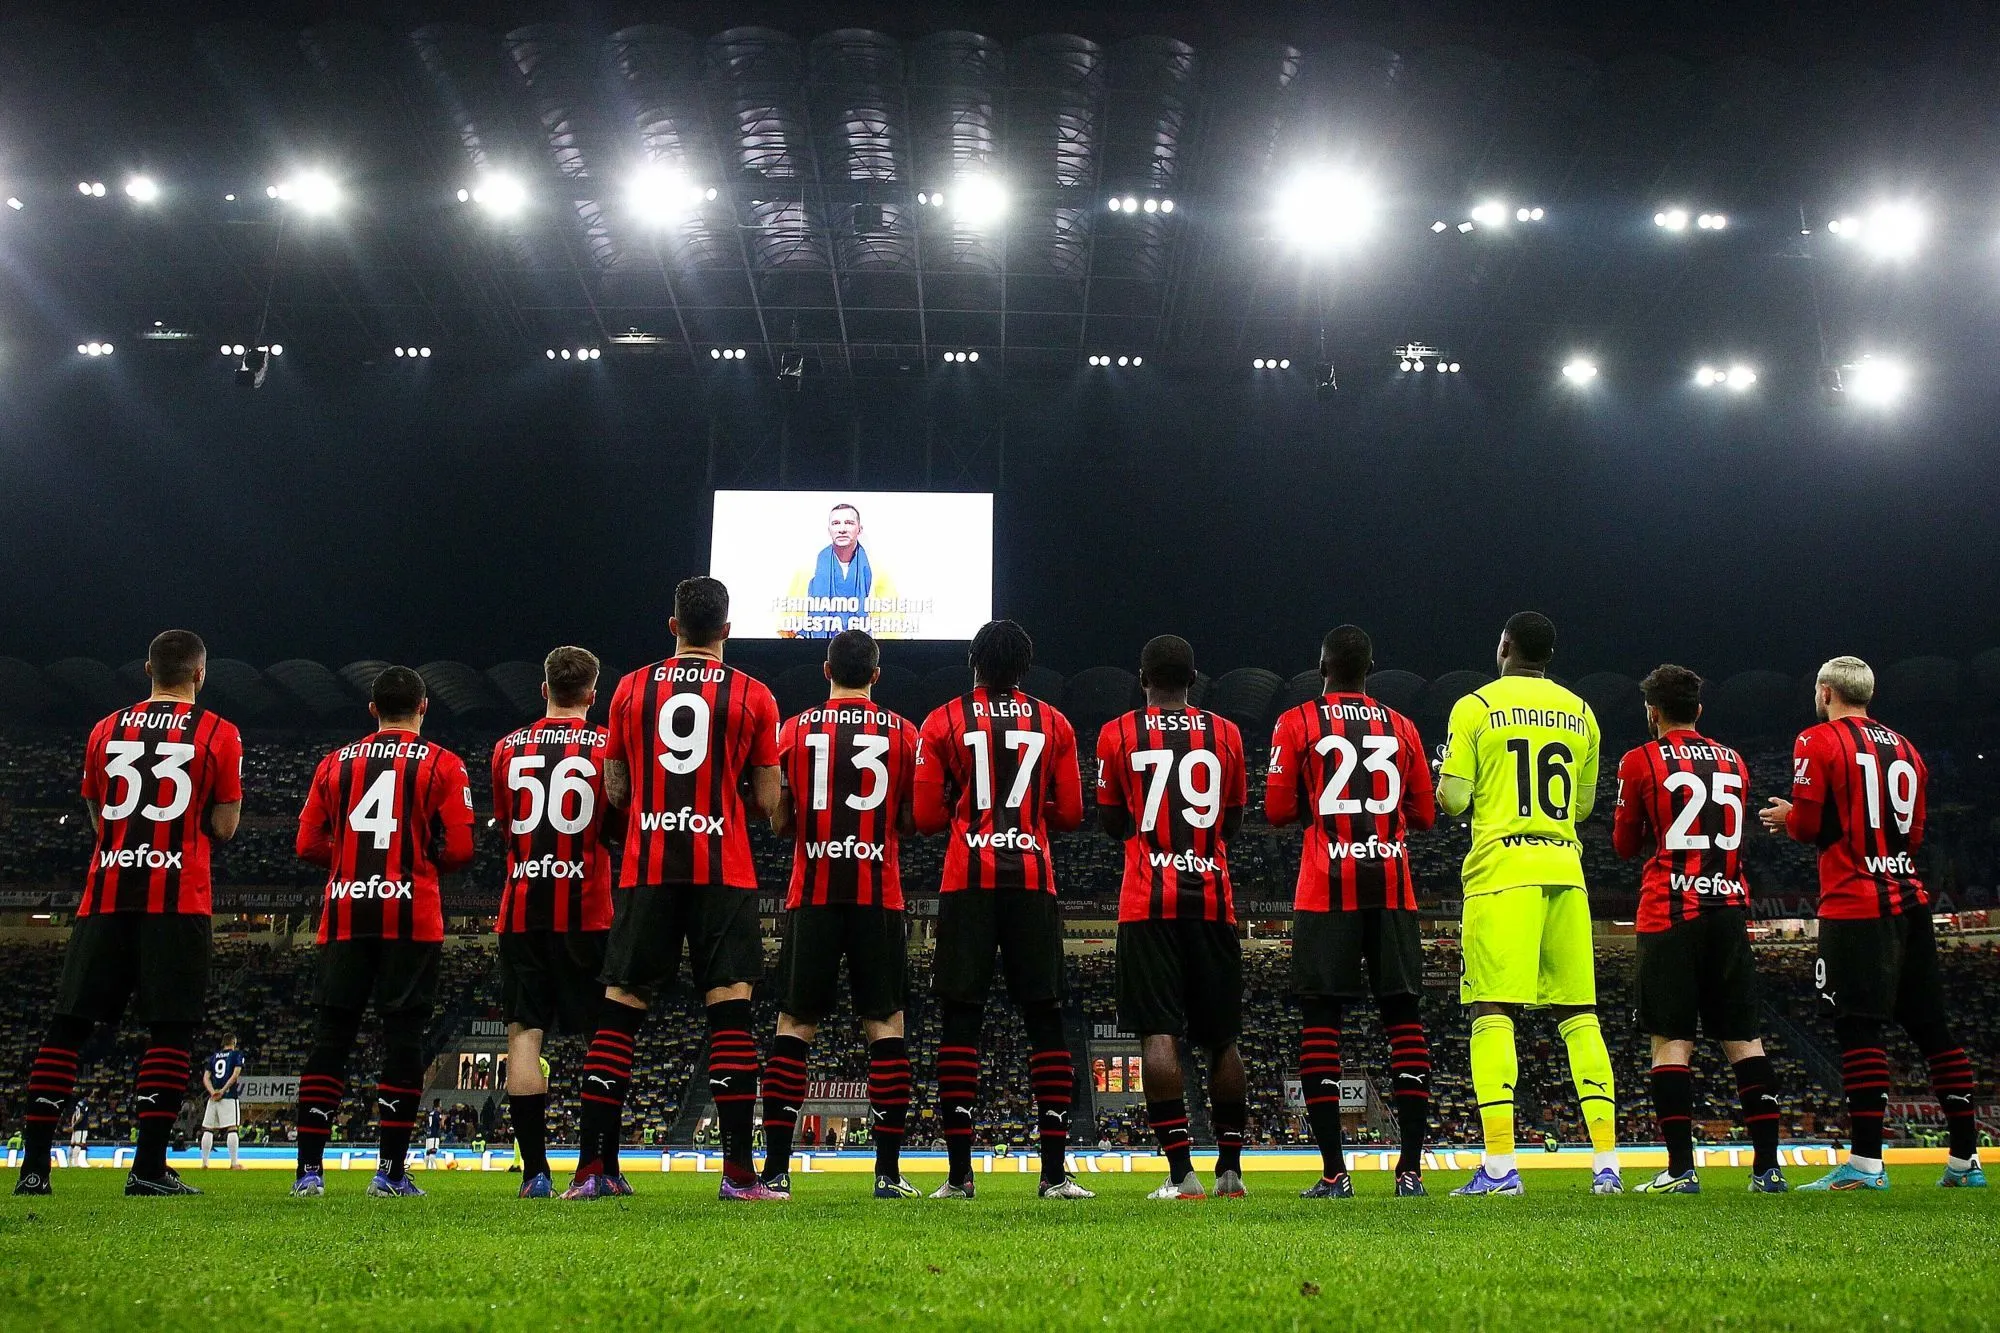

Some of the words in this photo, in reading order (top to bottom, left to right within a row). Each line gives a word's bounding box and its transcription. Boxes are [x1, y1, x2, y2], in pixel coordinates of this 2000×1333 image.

[772, 596, 859, 613] FERMIAMO
[864, 596, 934, 613] INSIEME
[781, 615, 843, 633] QUESTA
[653, 666, 726, 683] GIROUD
[798, 707, 901, 730] ROMAGNOLI
[972, 699, 1033, 718] R.LEÃO
[1320, 704, 1387, 723] TOMORI
[120, 711, 193, 731] KRUNIĆ
[1144, 714, 1207, 731] KESSIE
[504, 728, 607, 750] SAELEMAEKERS
[657, 692, 711, 775] 9
[1861, 726, 1900, 746] THEO
[337, 742, 430, 762] BENNACER
[1658, 745, 1738, 764] FLORENZI
[101, 740, 196, 822] 33
[804, 733, 890, 811] 13
[964, 730, 1046, 810] 17
[1314, 735, 1401, 816] 23
[1507, 739, 1573, 820] 16
[507, 755, 597, 835] 56
[1130, 748, 1222, 833] 79
[1855, 752, 1918, 835] 19
[348, 769, 398, 850] 4
[640, 806, 725, 836] wefox
[1662, 771, 1743, 851] 25
[100, 843, 183, 869] wefox
[805, 834, 885, 862] wefox
[1328, 835, 1403, 860] wefox
[513, 853, 585, 879] wefox
[1148, 848, 1221, 873] wefox
[1864, 851, 1916, 875] wefo
[330, 874, 412, 900] wefox
[1670, 872, 1746, 896] wefox
[1752, 897, 1818, 918] MILA
[214, 1059, 227, 1079] 9
[247, 1082, 299, 1097] BitME
[808, 1082, 827, 1098] FLY
[829, 1082, 868, 1098] BETTER
